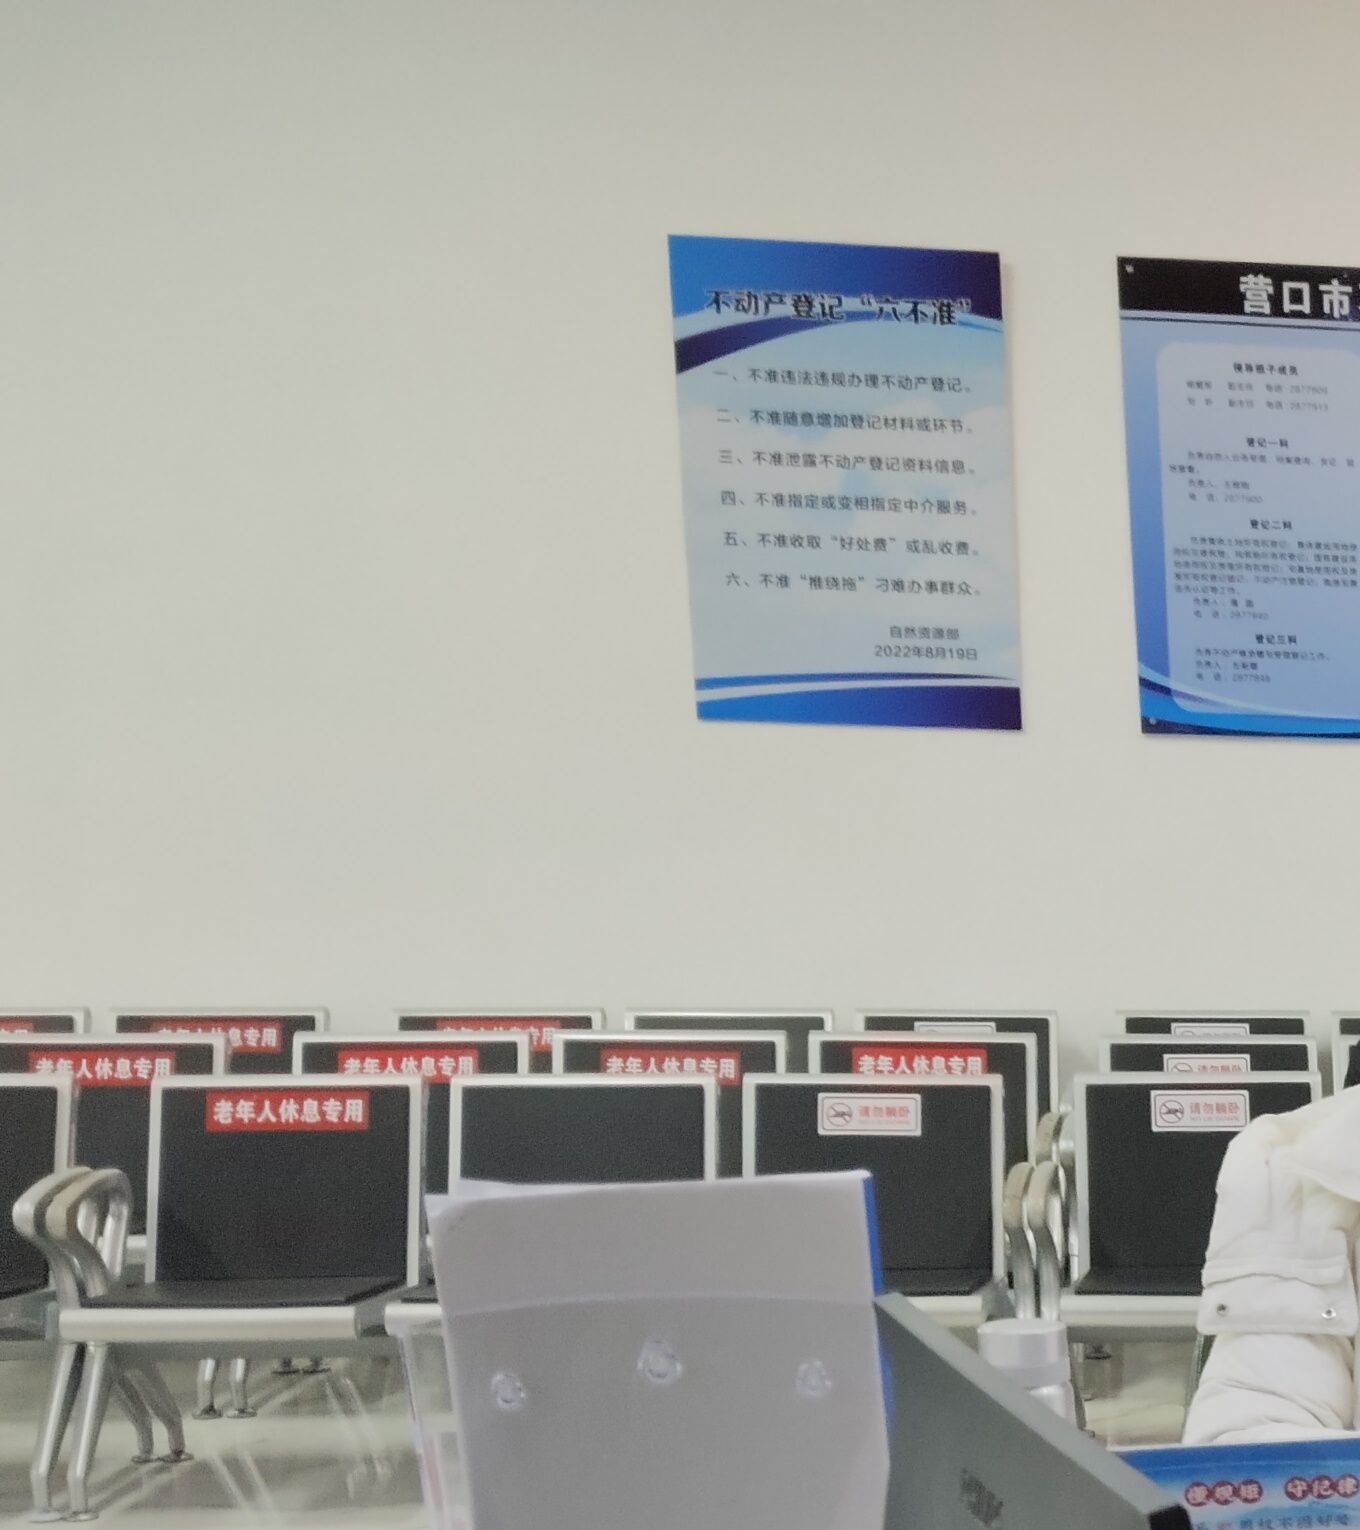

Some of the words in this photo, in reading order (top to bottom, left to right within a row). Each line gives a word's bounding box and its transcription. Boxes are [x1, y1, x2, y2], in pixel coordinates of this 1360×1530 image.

[705, 288, 972, 327] 不动产登记“六不准”
[213, 1098, 364, 1124] 老年人休息专用
